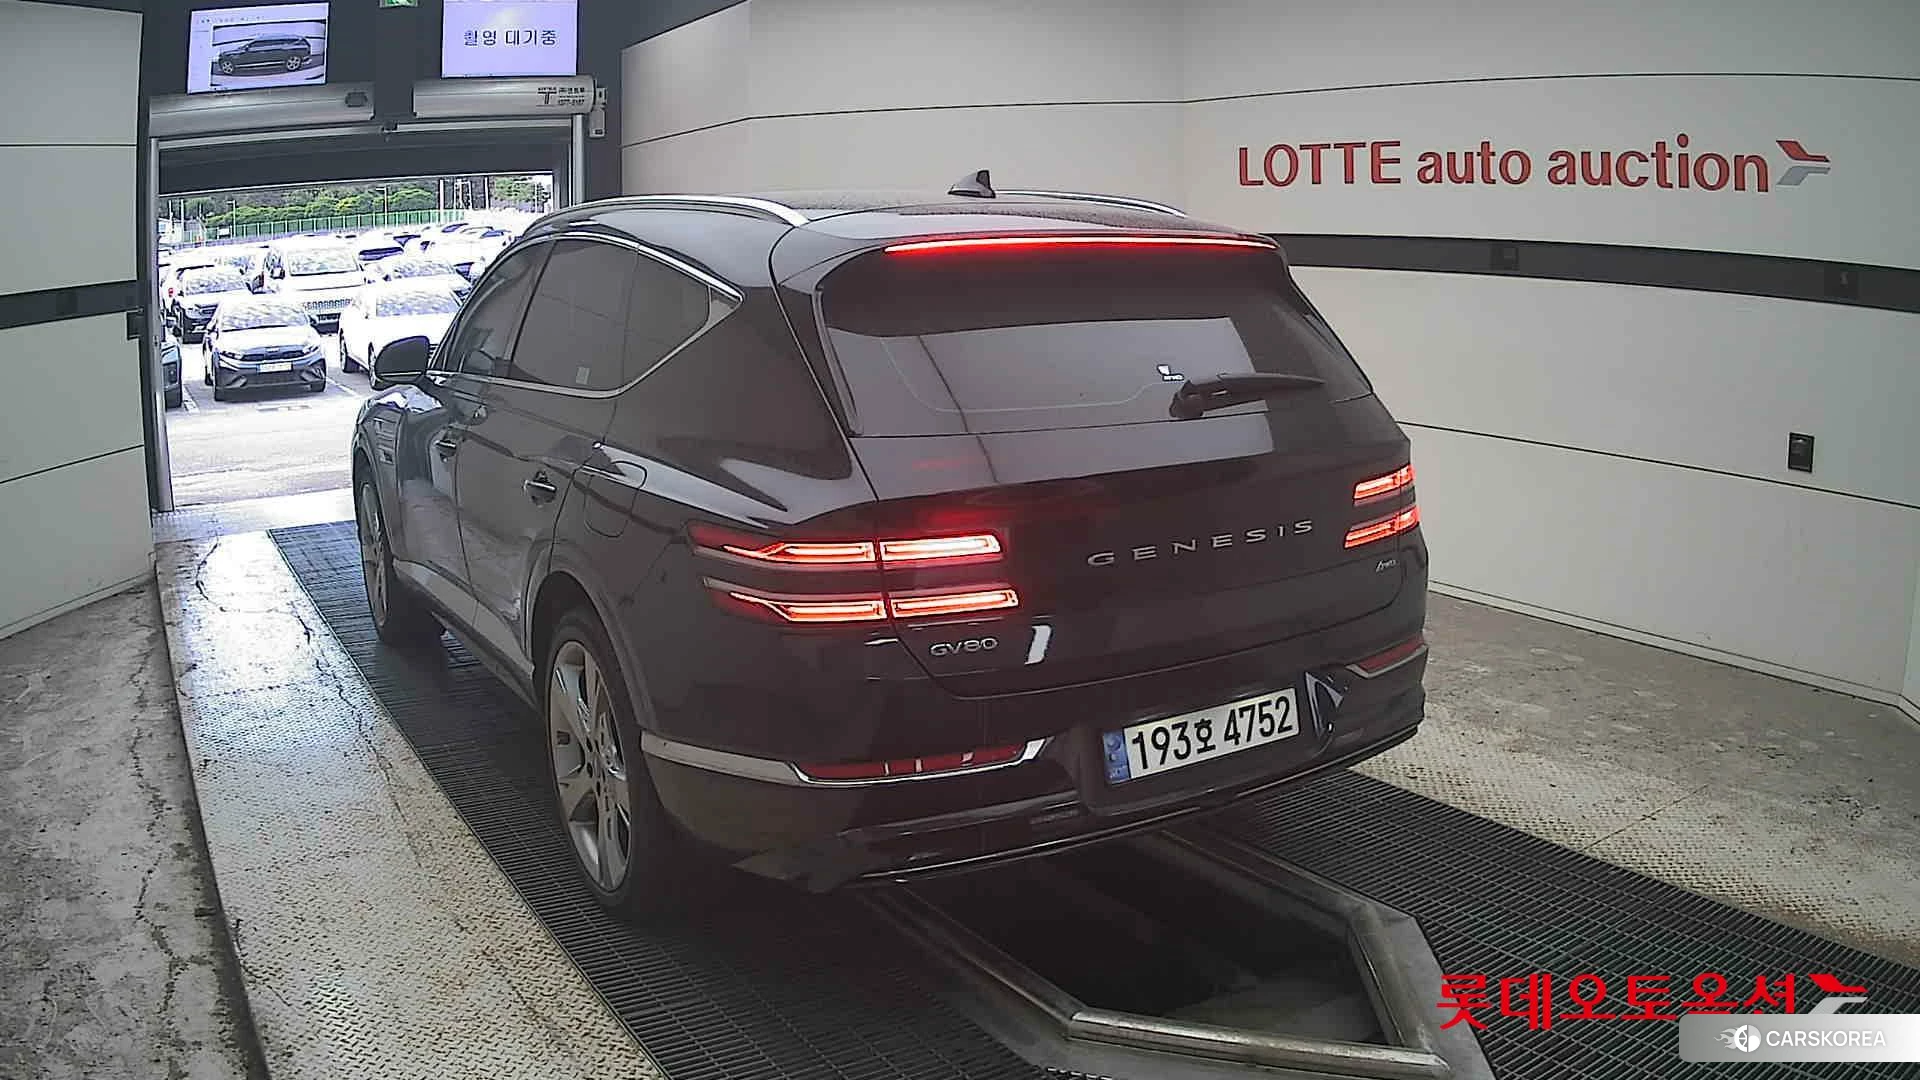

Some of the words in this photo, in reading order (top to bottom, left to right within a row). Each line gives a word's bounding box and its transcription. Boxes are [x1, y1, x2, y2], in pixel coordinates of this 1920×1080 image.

[504, 30, 557, 46] 대기중
[1238, 140, 1401, 187] LOTTE
[1416, 140, 1532, 186] auto
[1547, 132, 1770, 193] auction
[1086, 519, 1314, 568] GENESIS
[929, 636, 999, 657] GV80
[1131, 717, 1217, 770] 193호
[1223, 695, 1294, 746] 4752
